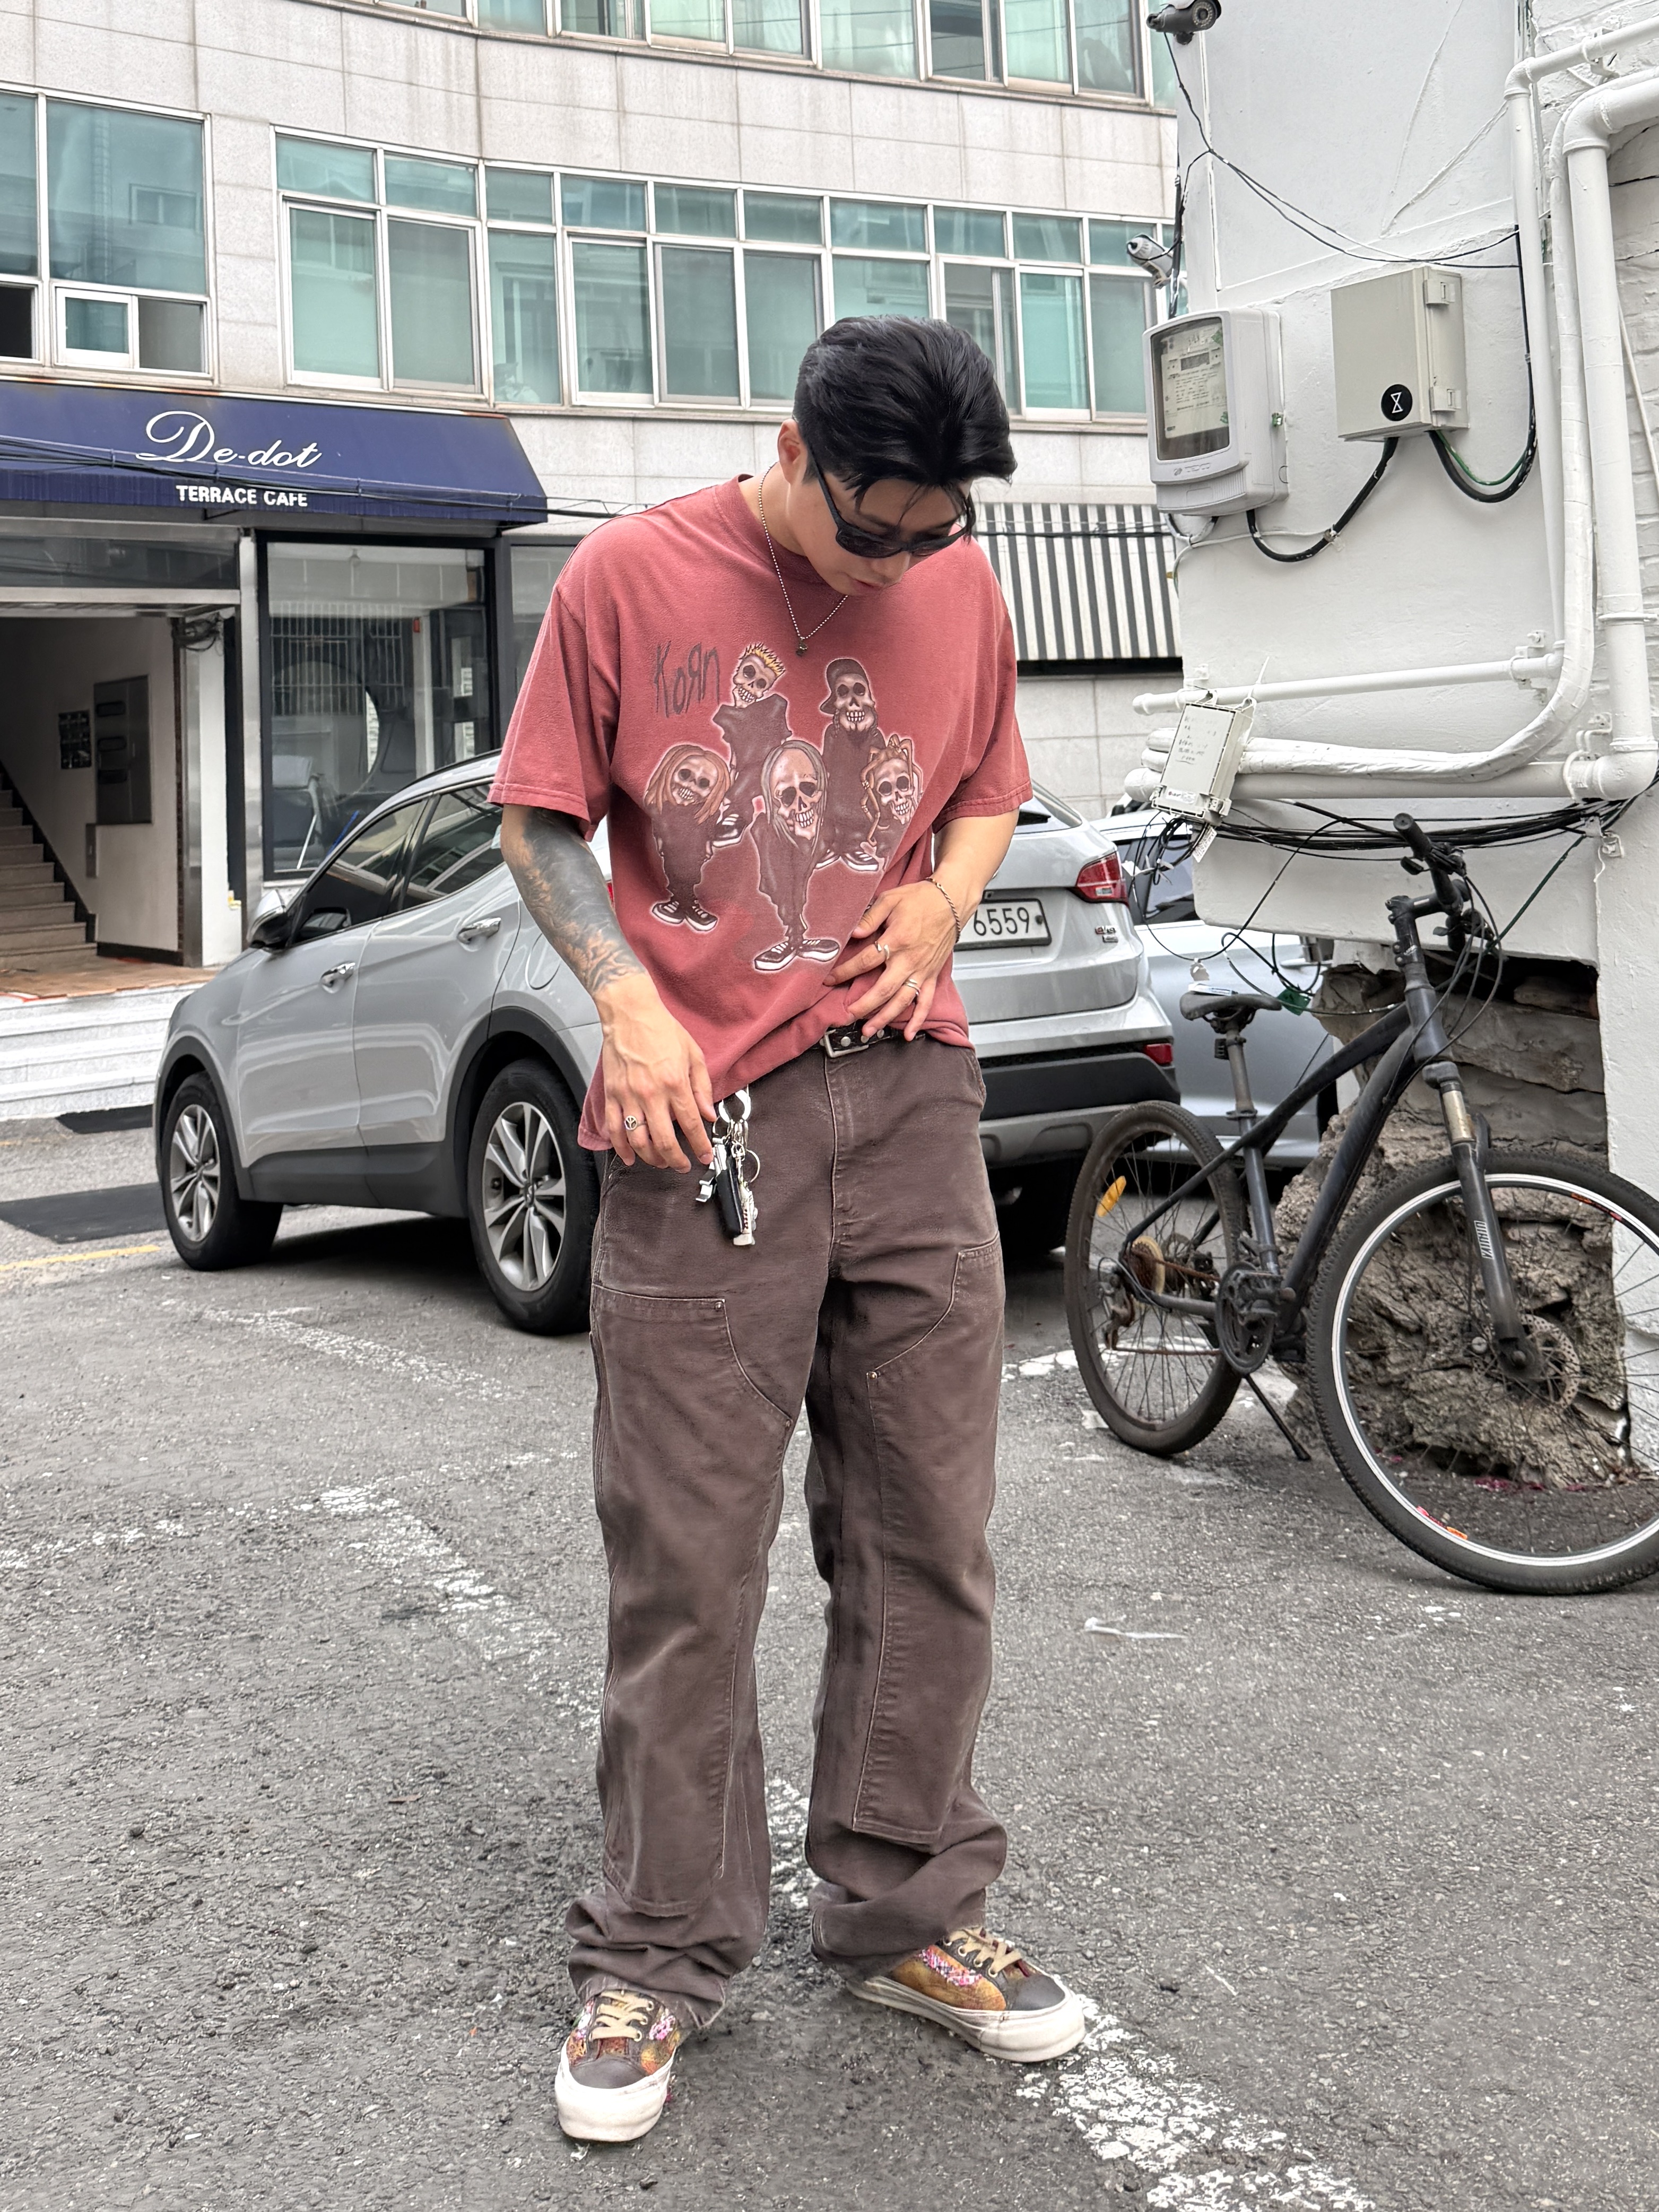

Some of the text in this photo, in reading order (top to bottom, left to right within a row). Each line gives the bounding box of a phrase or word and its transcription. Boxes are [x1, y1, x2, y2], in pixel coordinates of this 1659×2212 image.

[135, 411, 323, 468] De-dot
[176, 485, 308, 507] TERRACE CAFE
[973, 907, 1030, 936] 6559
